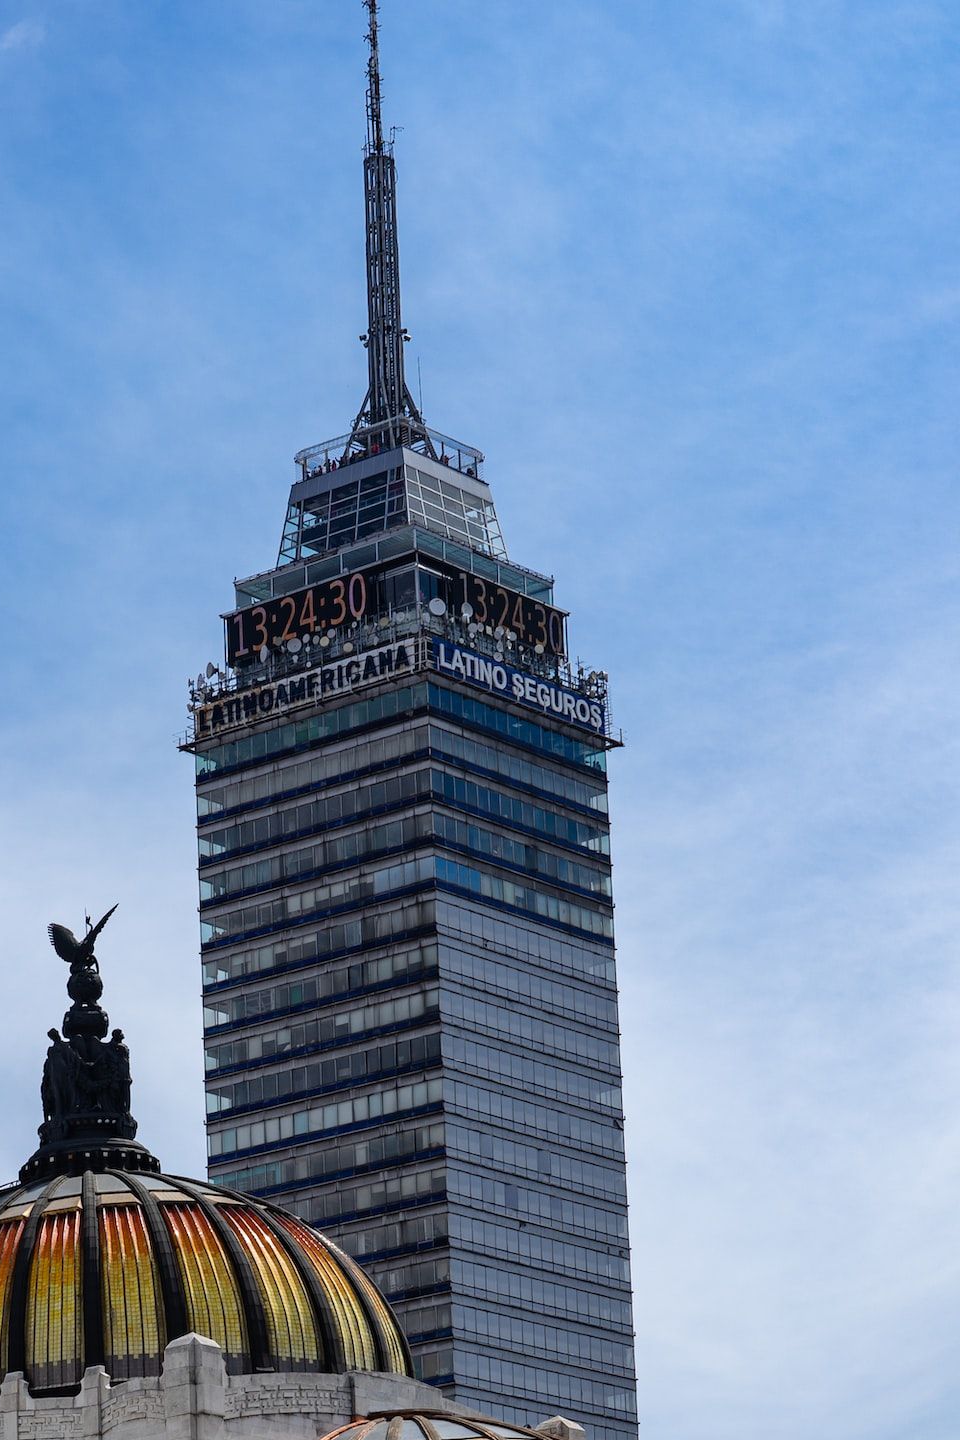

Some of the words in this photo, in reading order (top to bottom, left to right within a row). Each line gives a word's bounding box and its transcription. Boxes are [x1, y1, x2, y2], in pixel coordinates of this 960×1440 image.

[233, 573, 367, 658] 13:24:30
[198, 645, 410, 732] LATINOAMERICANA
[439, 643, 508, 690] LATINO
[511, 673, 603, 728] SEGUROS
